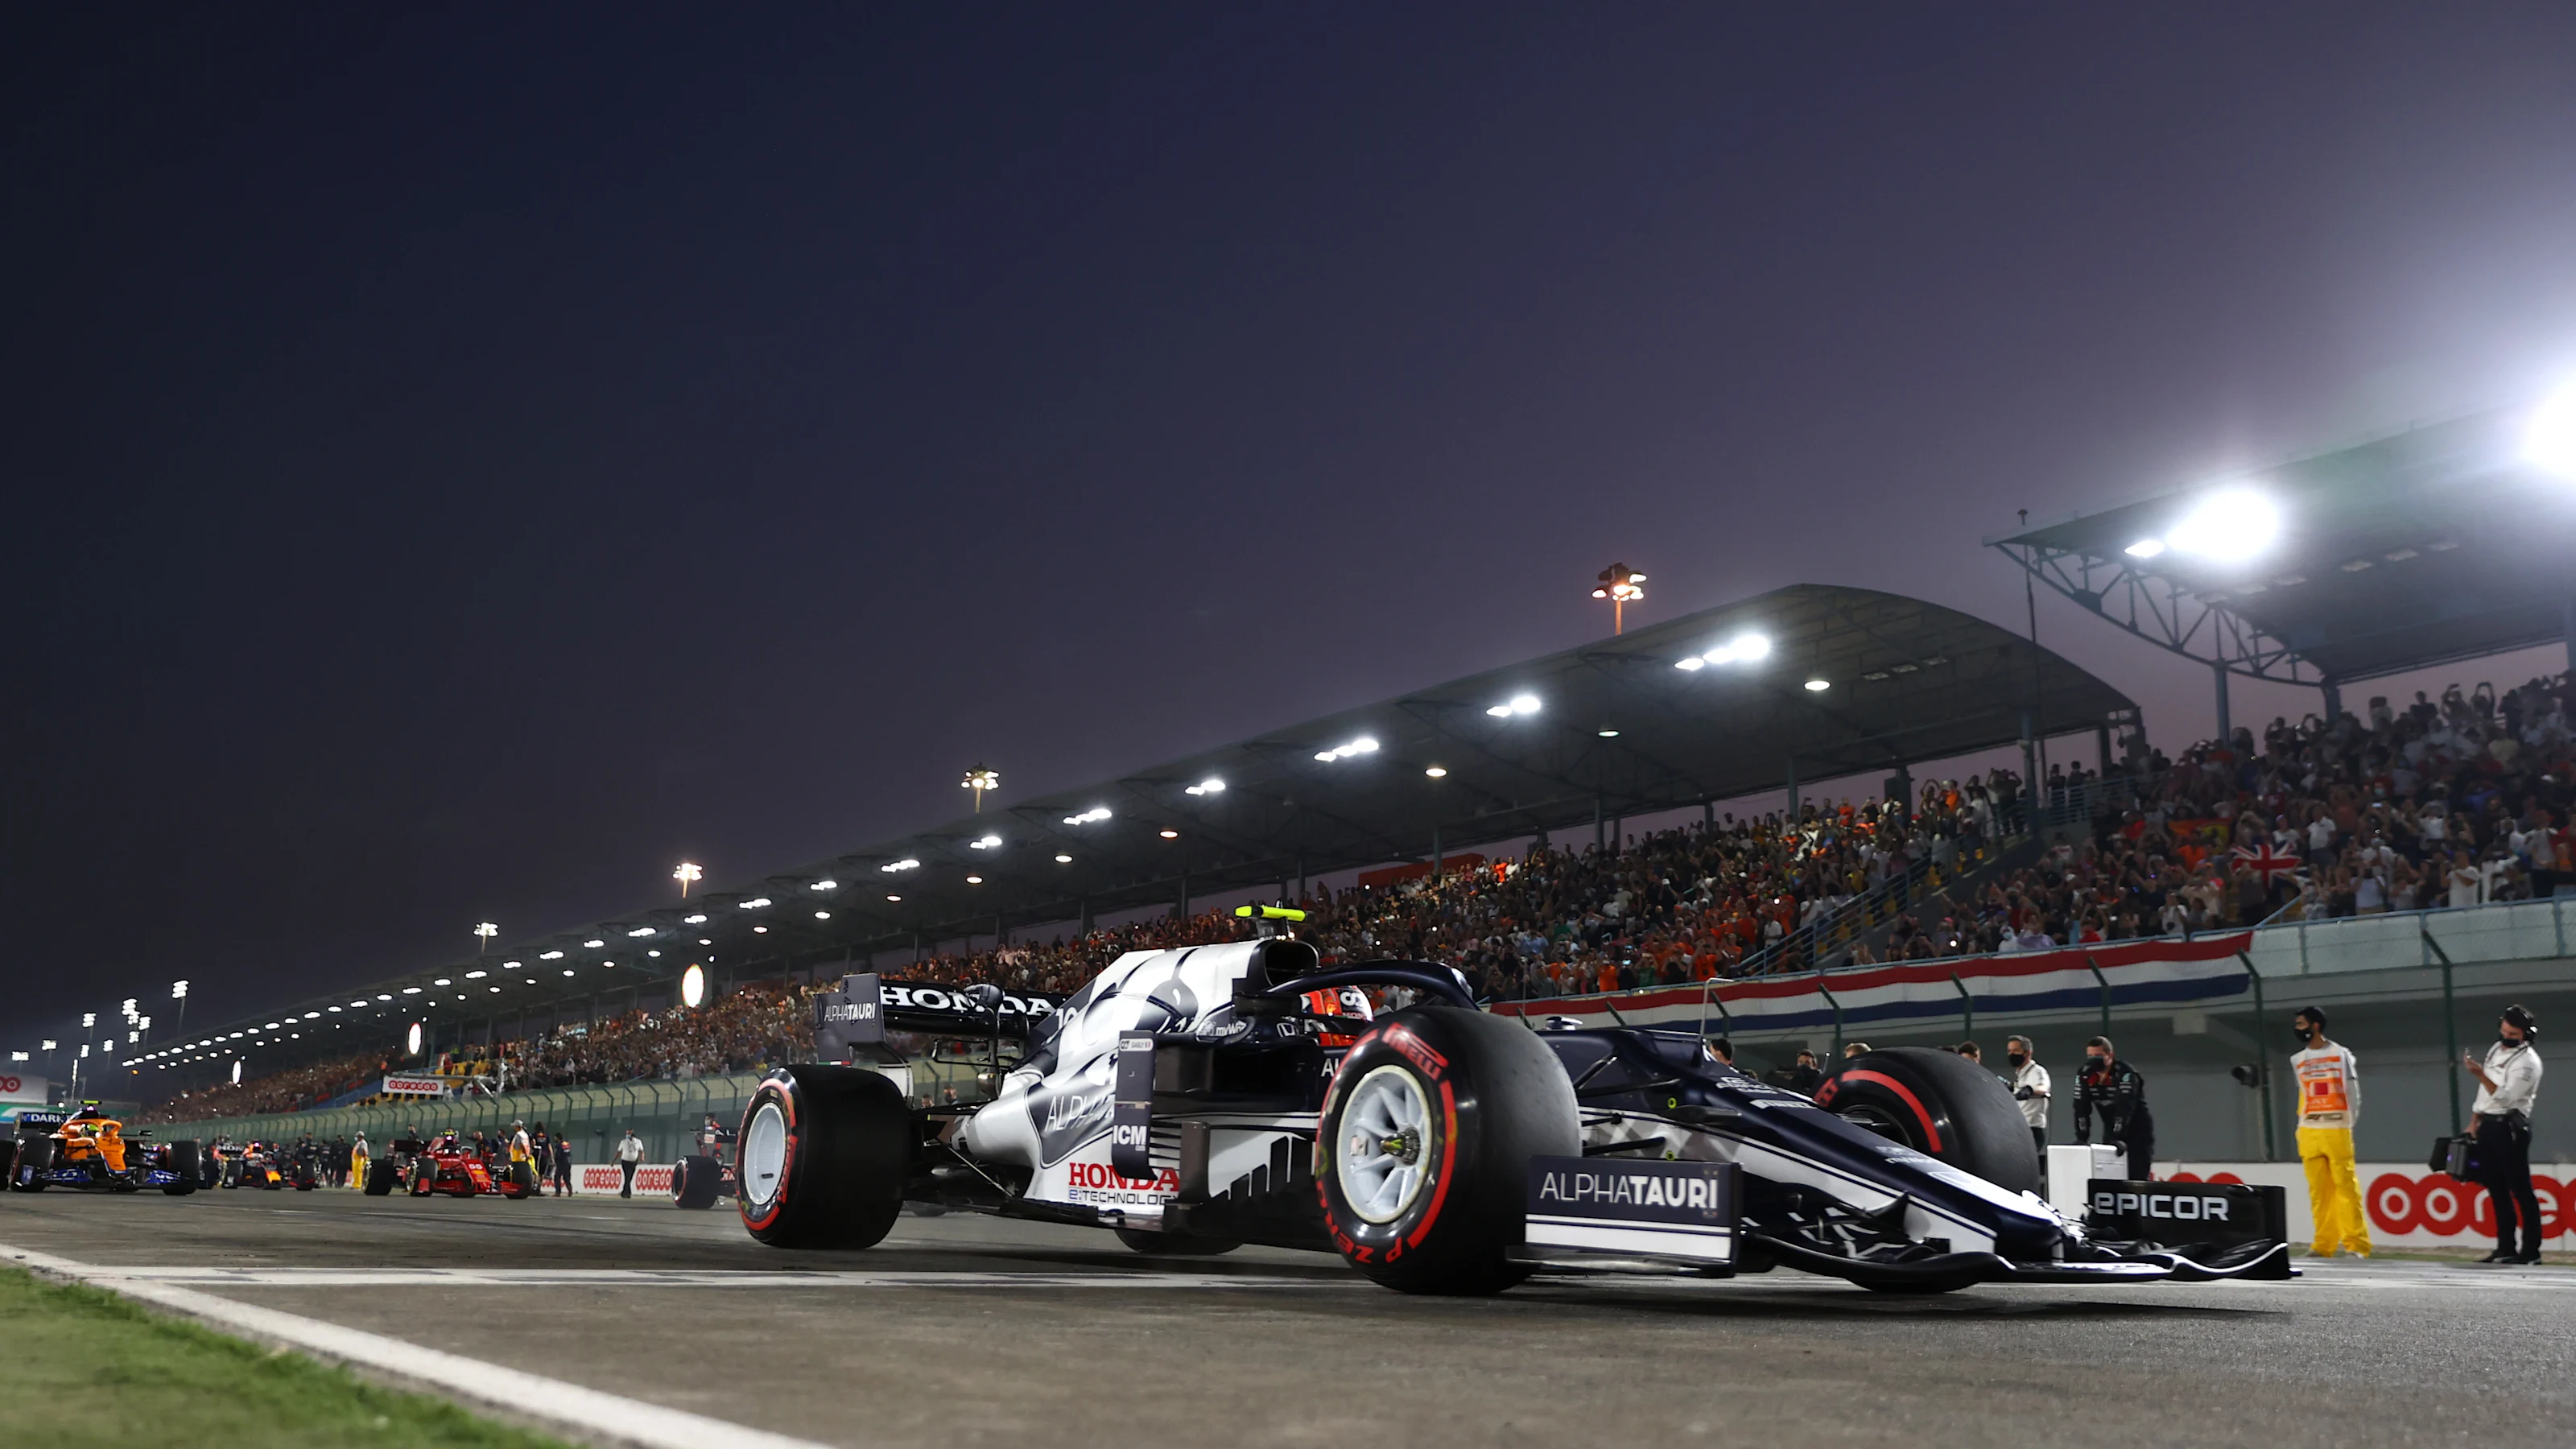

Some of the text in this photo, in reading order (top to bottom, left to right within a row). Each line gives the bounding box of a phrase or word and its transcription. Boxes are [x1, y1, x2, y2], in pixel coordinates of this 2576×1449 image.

[824, 1002, 876, 1021] ALPHATAURI
[390, 1080, 437, 1091] ooredoo
[1113, 1125, 1147, 1145] ICM
[584, 1170, 621, 1189] ooredoo
[636, 1170, 674, 1189] ooredo
[1540, 1172, 1718, 1208] ALPHATAURI
